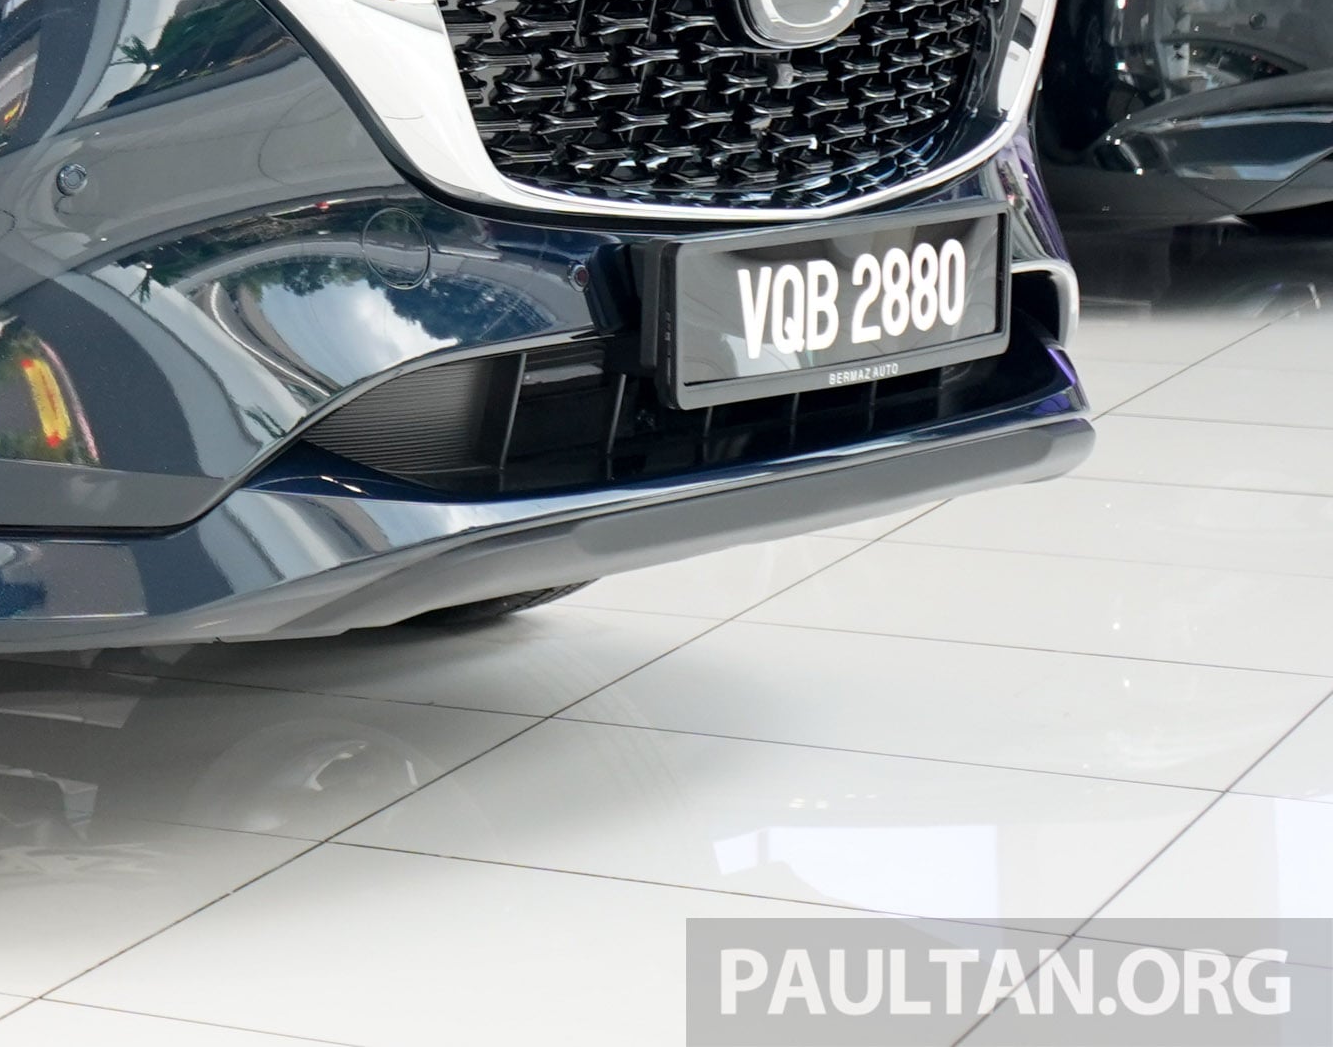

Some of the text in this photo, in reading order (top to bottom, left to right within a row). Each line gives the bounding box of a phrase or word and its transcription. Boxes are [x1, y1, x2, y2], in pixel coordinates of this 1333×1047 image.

[737, 238, 966, 359] VQB 2880
[829, 362, 899, 385] BERMAZ AUTO
